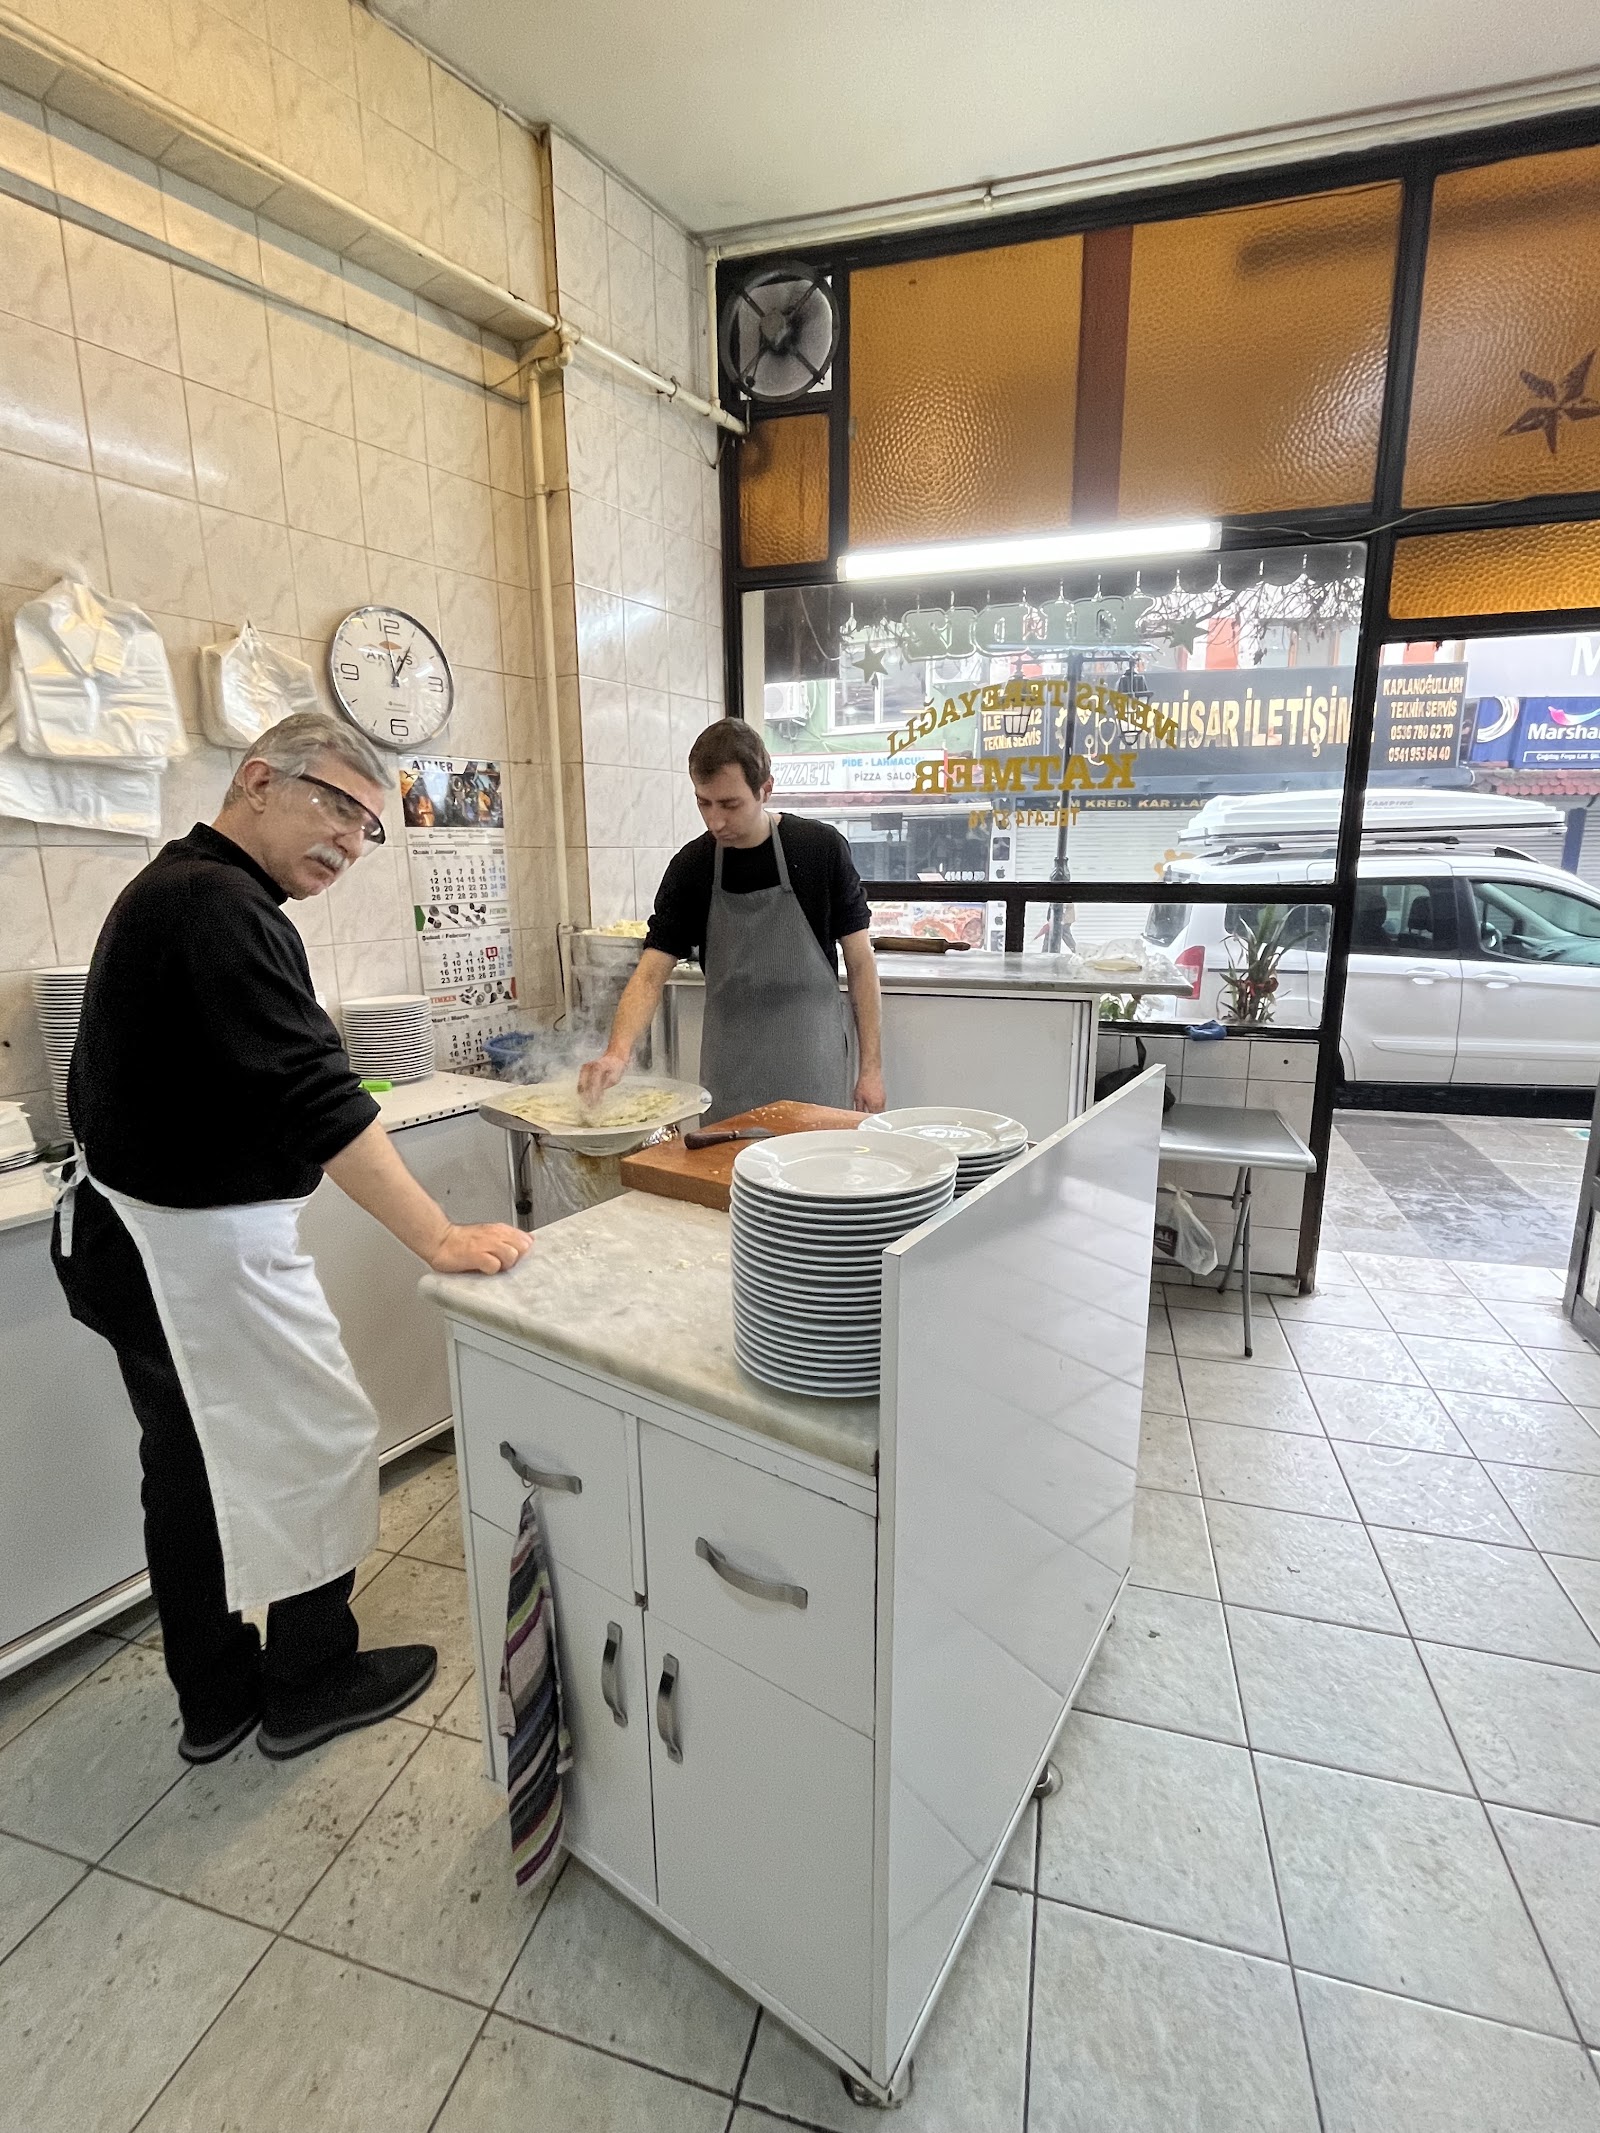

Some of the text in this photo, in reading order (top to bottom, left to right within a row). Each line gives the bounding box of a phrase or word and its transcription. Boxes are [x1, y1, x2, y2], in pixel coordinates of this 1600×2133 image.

[379, 618, 400, 635] 12
[341, 663, 359, 680] 9
[428, 676, 444, 693] 3
[1391, 696, 1457, 718] TEKNİK SERVİS
[390, 718, 409, 736] 6
[1527, 722, 1600, 740] Marsha
[412, 760, 453, 772] ATER
[854, 770, 881, 782] PİZZA
